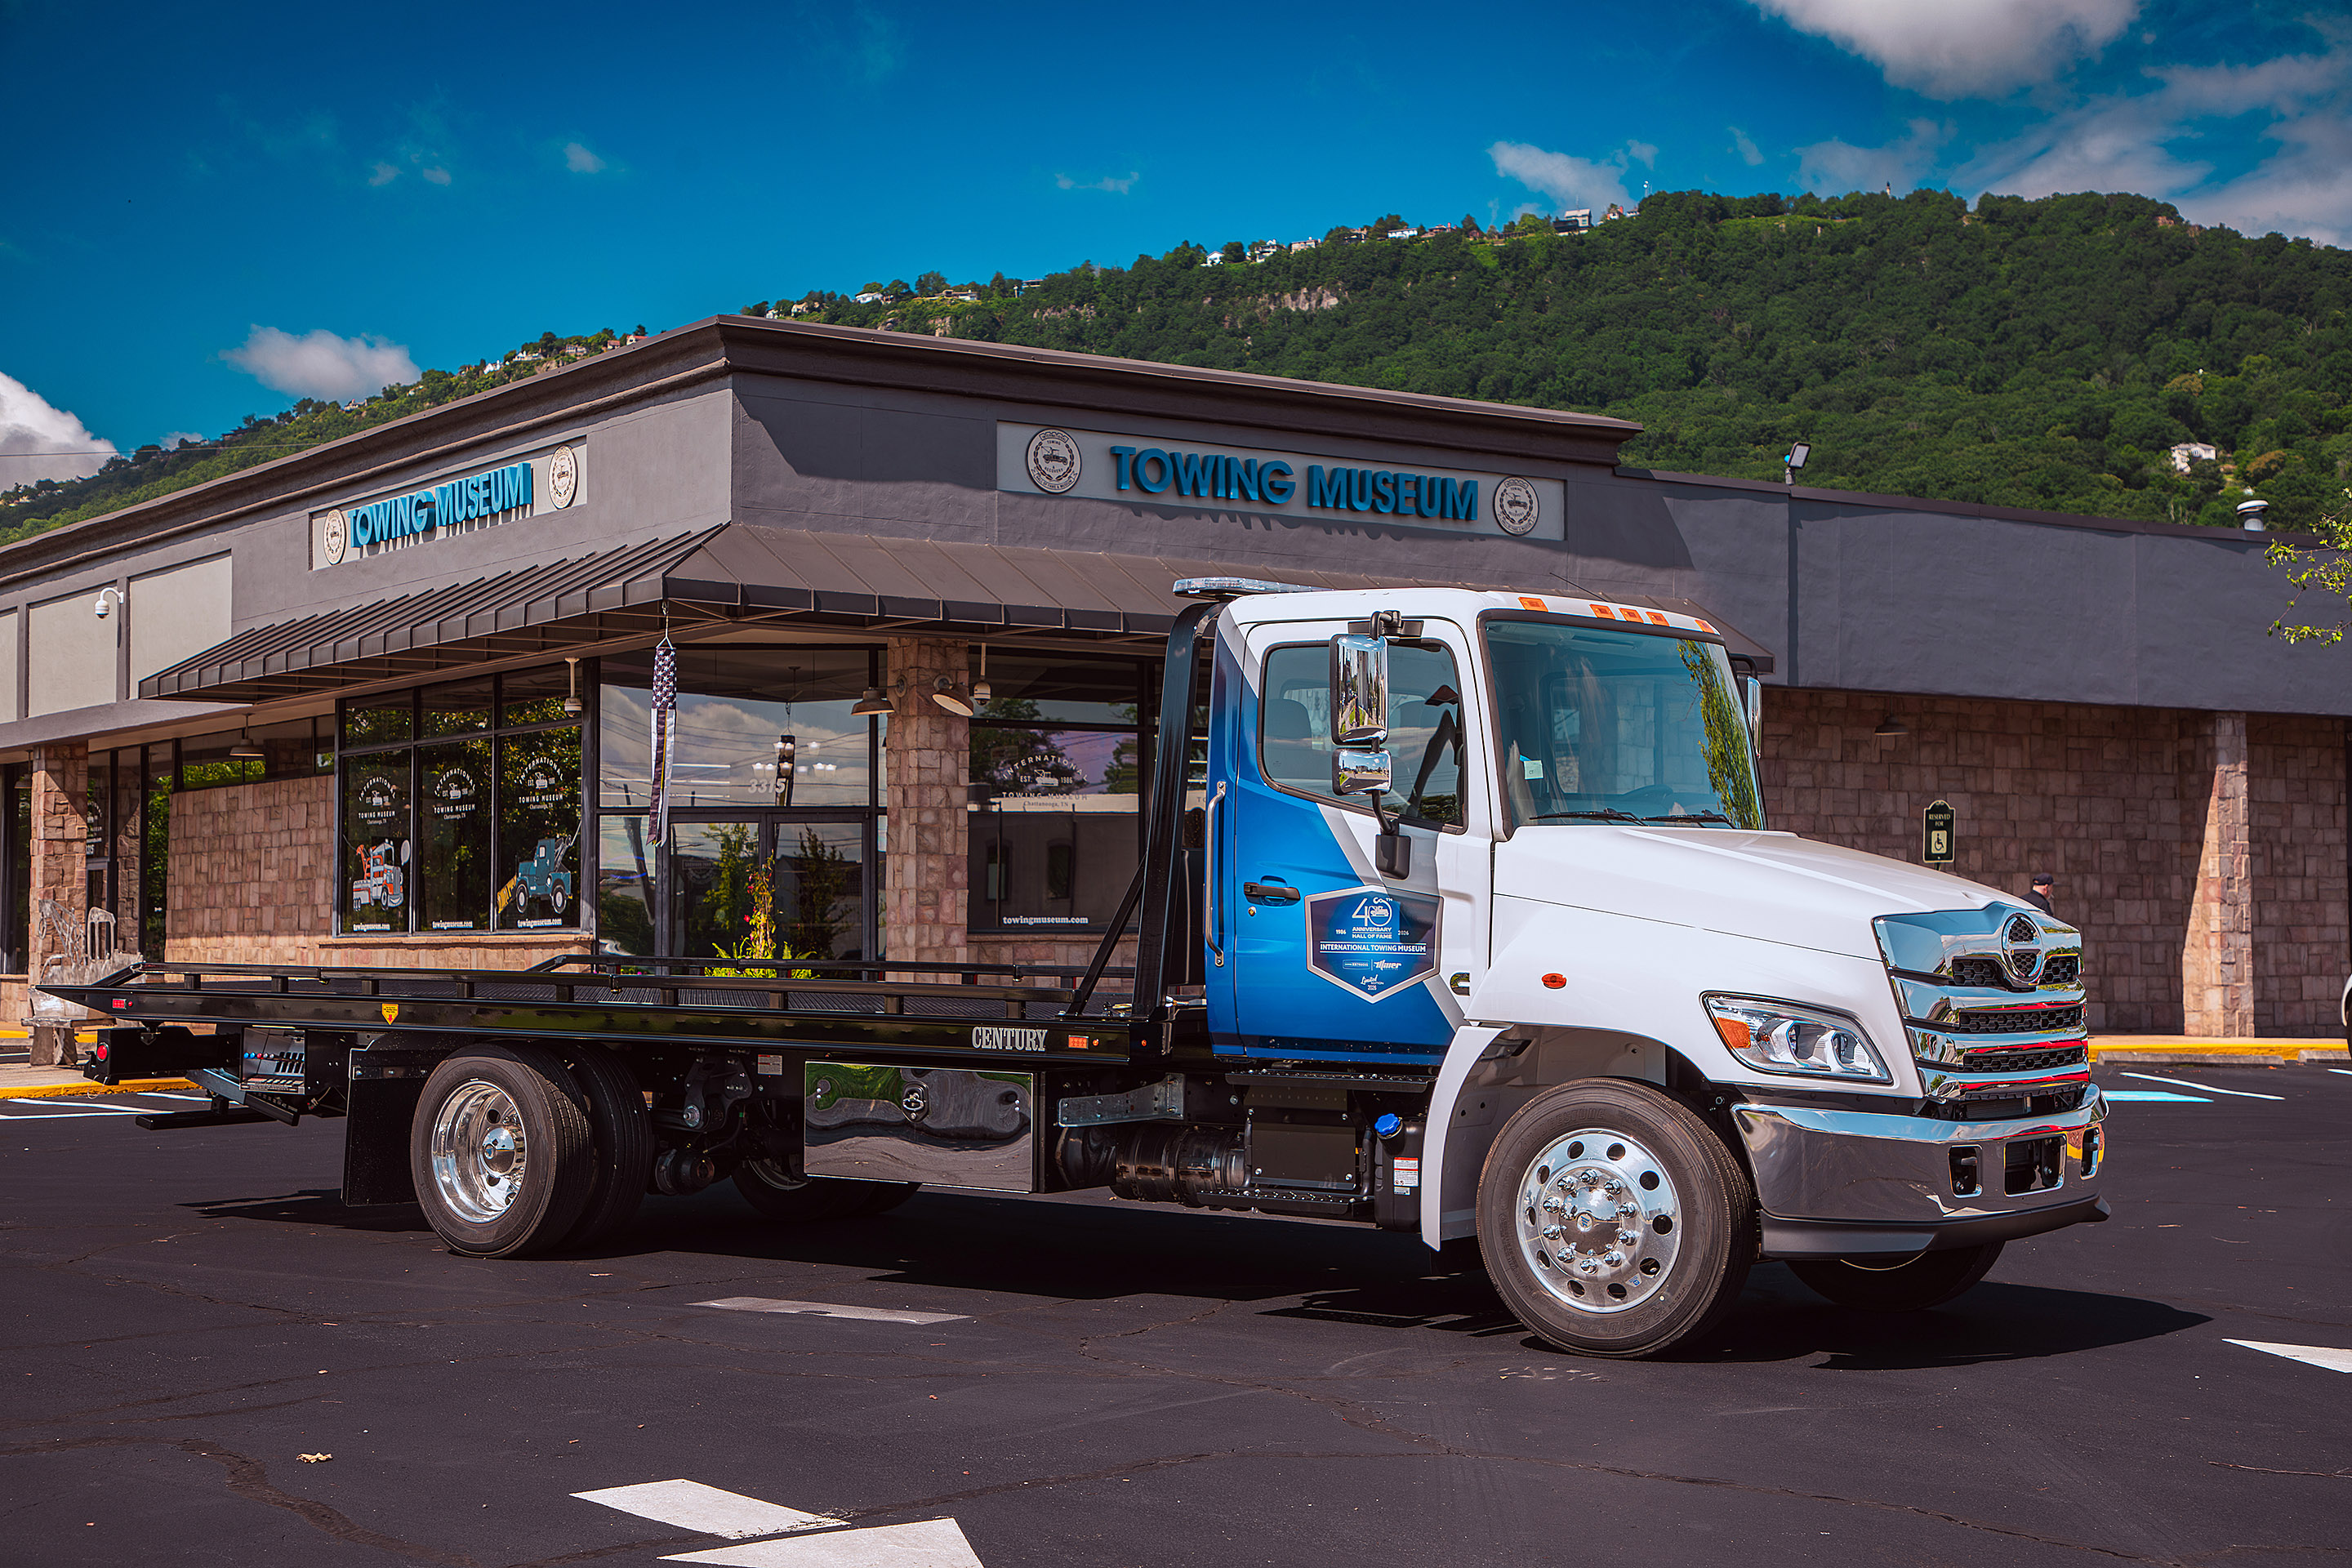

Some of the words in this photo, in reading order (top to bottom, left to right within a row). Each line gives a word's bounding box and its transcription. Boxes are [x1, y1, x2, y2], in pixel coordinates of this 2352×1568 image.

[1111, 445, 1297, 505] TOWING
[1307, 464, 1479, 521] MUSEUM
[347, 491, 435, 548] TOWING
[435, 462, 532, 528] MUSEUM
[519, 757, 564, 784] INTERNATIONAL
[1003, 755, 1088, 782] INTERNATIONAL
[434, 768, 475, 795] INTERNATIONAL
[748, 778, 786, 794] 3315
[434, 805, 453, 813] TOWING
[455, 804, 475, 812] MUSEUM
[519, 795, 539, 804] TOWING
[432, 920, 473, 930] towingmuseum.com
[517, 919, 563, 929] towingmuseum.com
[1003, 915, 1089, 925] towingmuseum.com
[972, 1026, 1048, 1051] CENTURY
